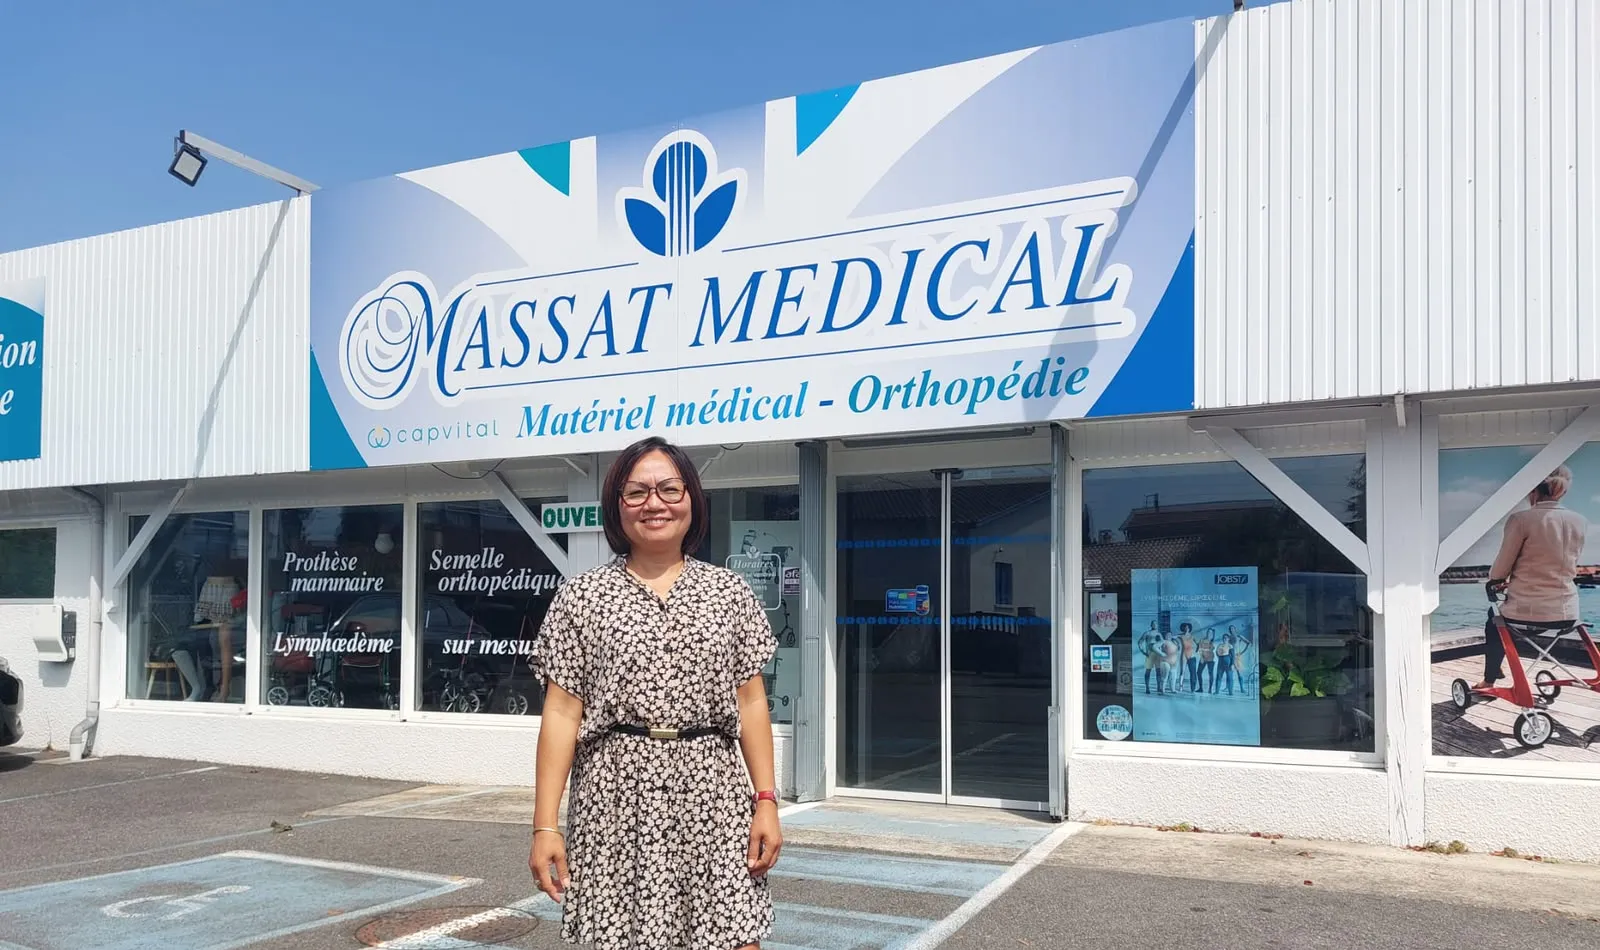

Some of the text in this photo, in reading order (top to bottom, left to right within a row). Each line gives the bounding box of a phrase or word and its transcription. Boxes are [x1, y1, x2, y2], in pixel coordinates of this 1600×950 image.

[346, 222, 1120, 401] MASSAT MEDICAL
[515, 390, 656, 439] Matériel
[665, 381, 808, 427] médical
[848, 356, 1090, 416] Orthopédie
[397, 419, 499, 446] capvital
[282, 551, 358, 572] Prothèse
[430, 547, 505, 571] Semelle
[732, 559, 774, 569] Horaires
[291, 571, 384, 592] mammaire
[1217, 573, 1242, 584] JOBST
[273, 627, 394, 657] Lymphœdème
[442, 639, 475, 654] sur
